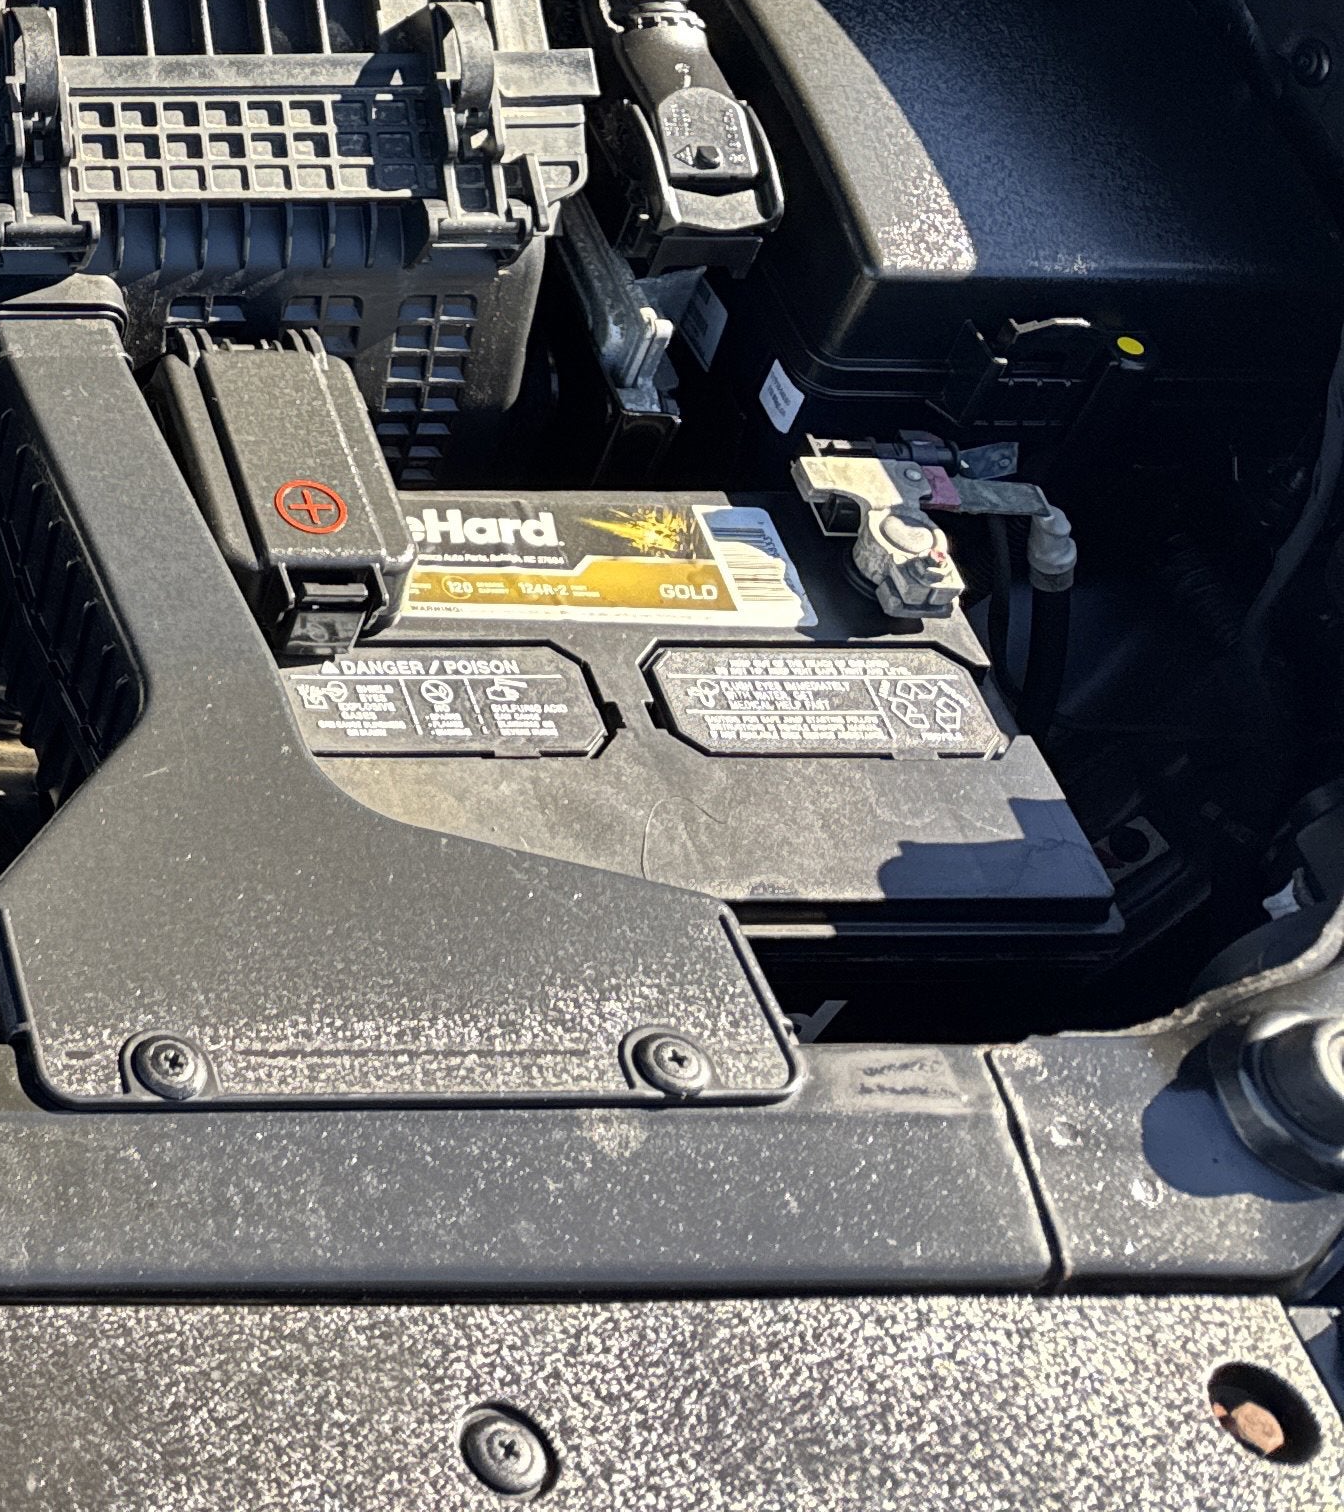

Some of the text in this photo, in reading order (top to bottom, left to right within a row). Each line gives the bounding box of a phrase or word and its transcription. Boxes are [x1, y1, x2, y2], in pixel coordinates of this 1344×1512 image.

[405, 508, 560, 547] eHard
[659, 583, 718, 600] GOLD
[340, 660, 425, 675] DANGER
[443, 659, 520, 675] POISON
[543, 704, 568, 713] ACID
